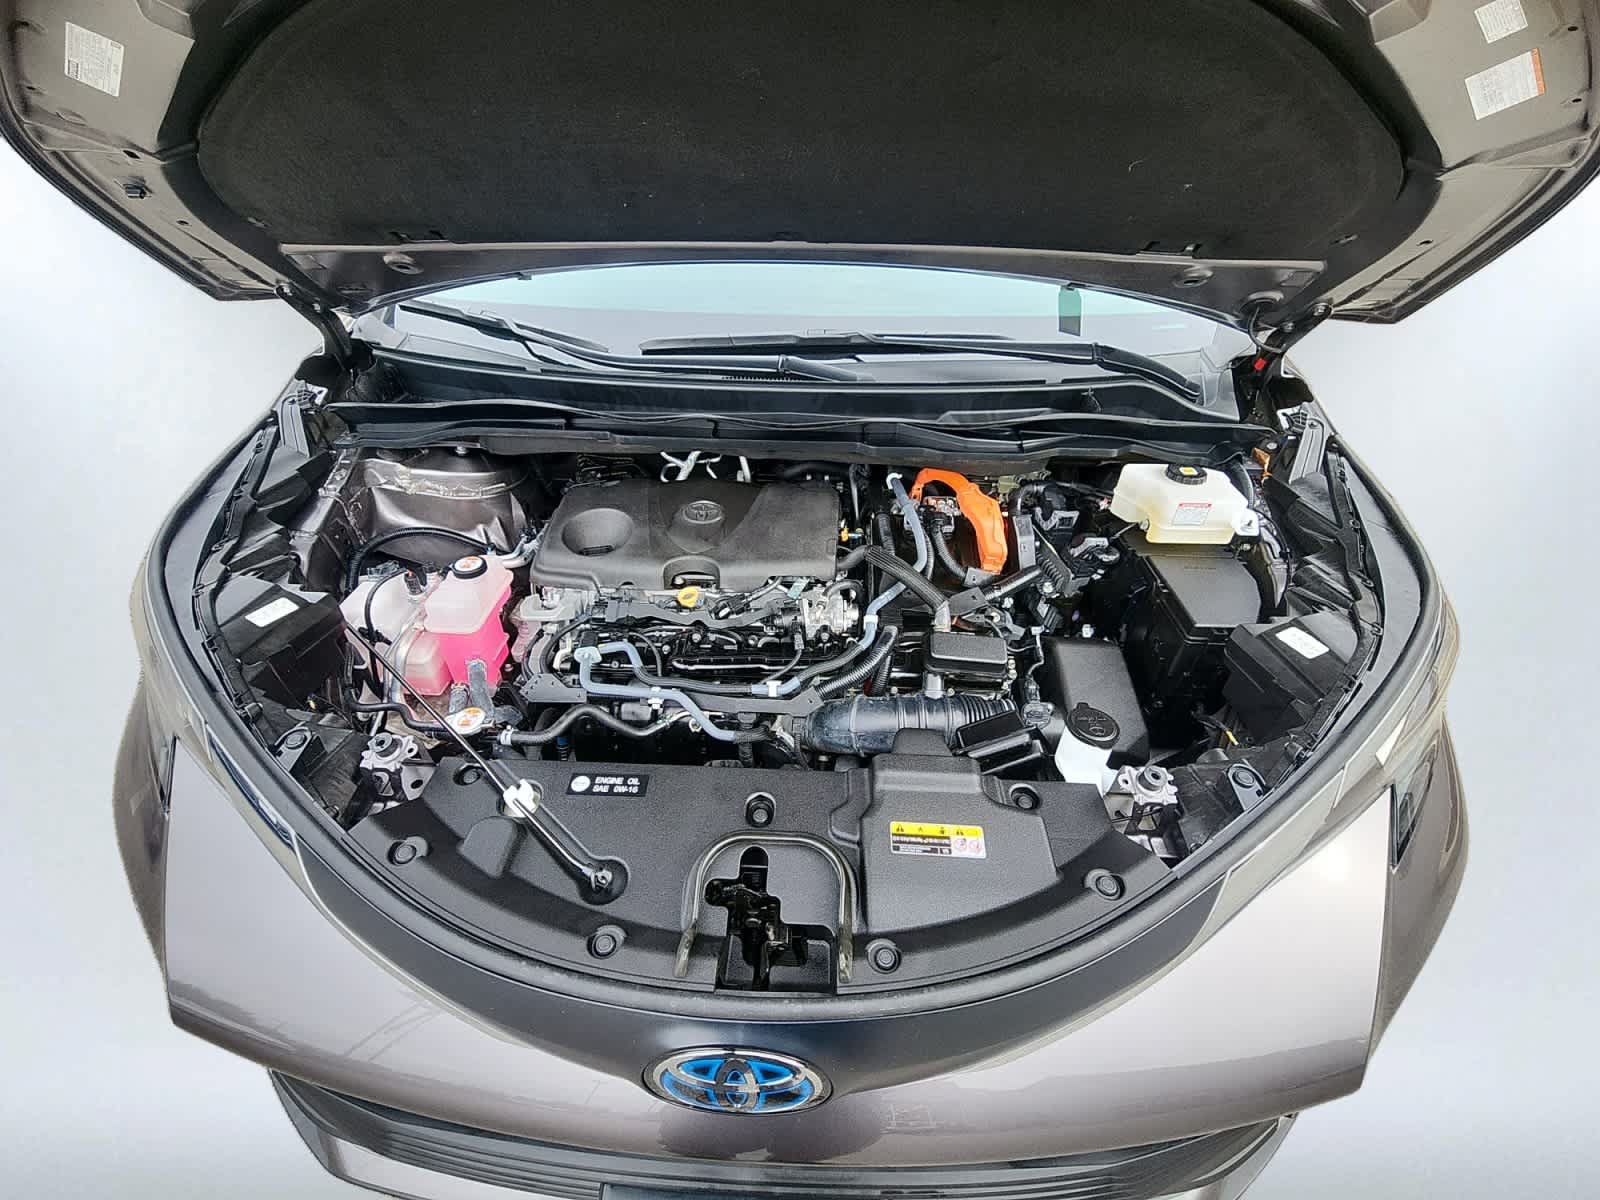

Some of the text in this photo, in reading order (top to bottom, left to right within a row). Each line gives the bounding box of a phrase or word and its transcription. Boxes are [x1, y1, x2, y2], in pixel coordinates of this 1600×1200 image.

[594, 776, 624, 785] ENGINE
[627, 777, 640, 786] OIL
[592, 785, 610, 793] SAE
